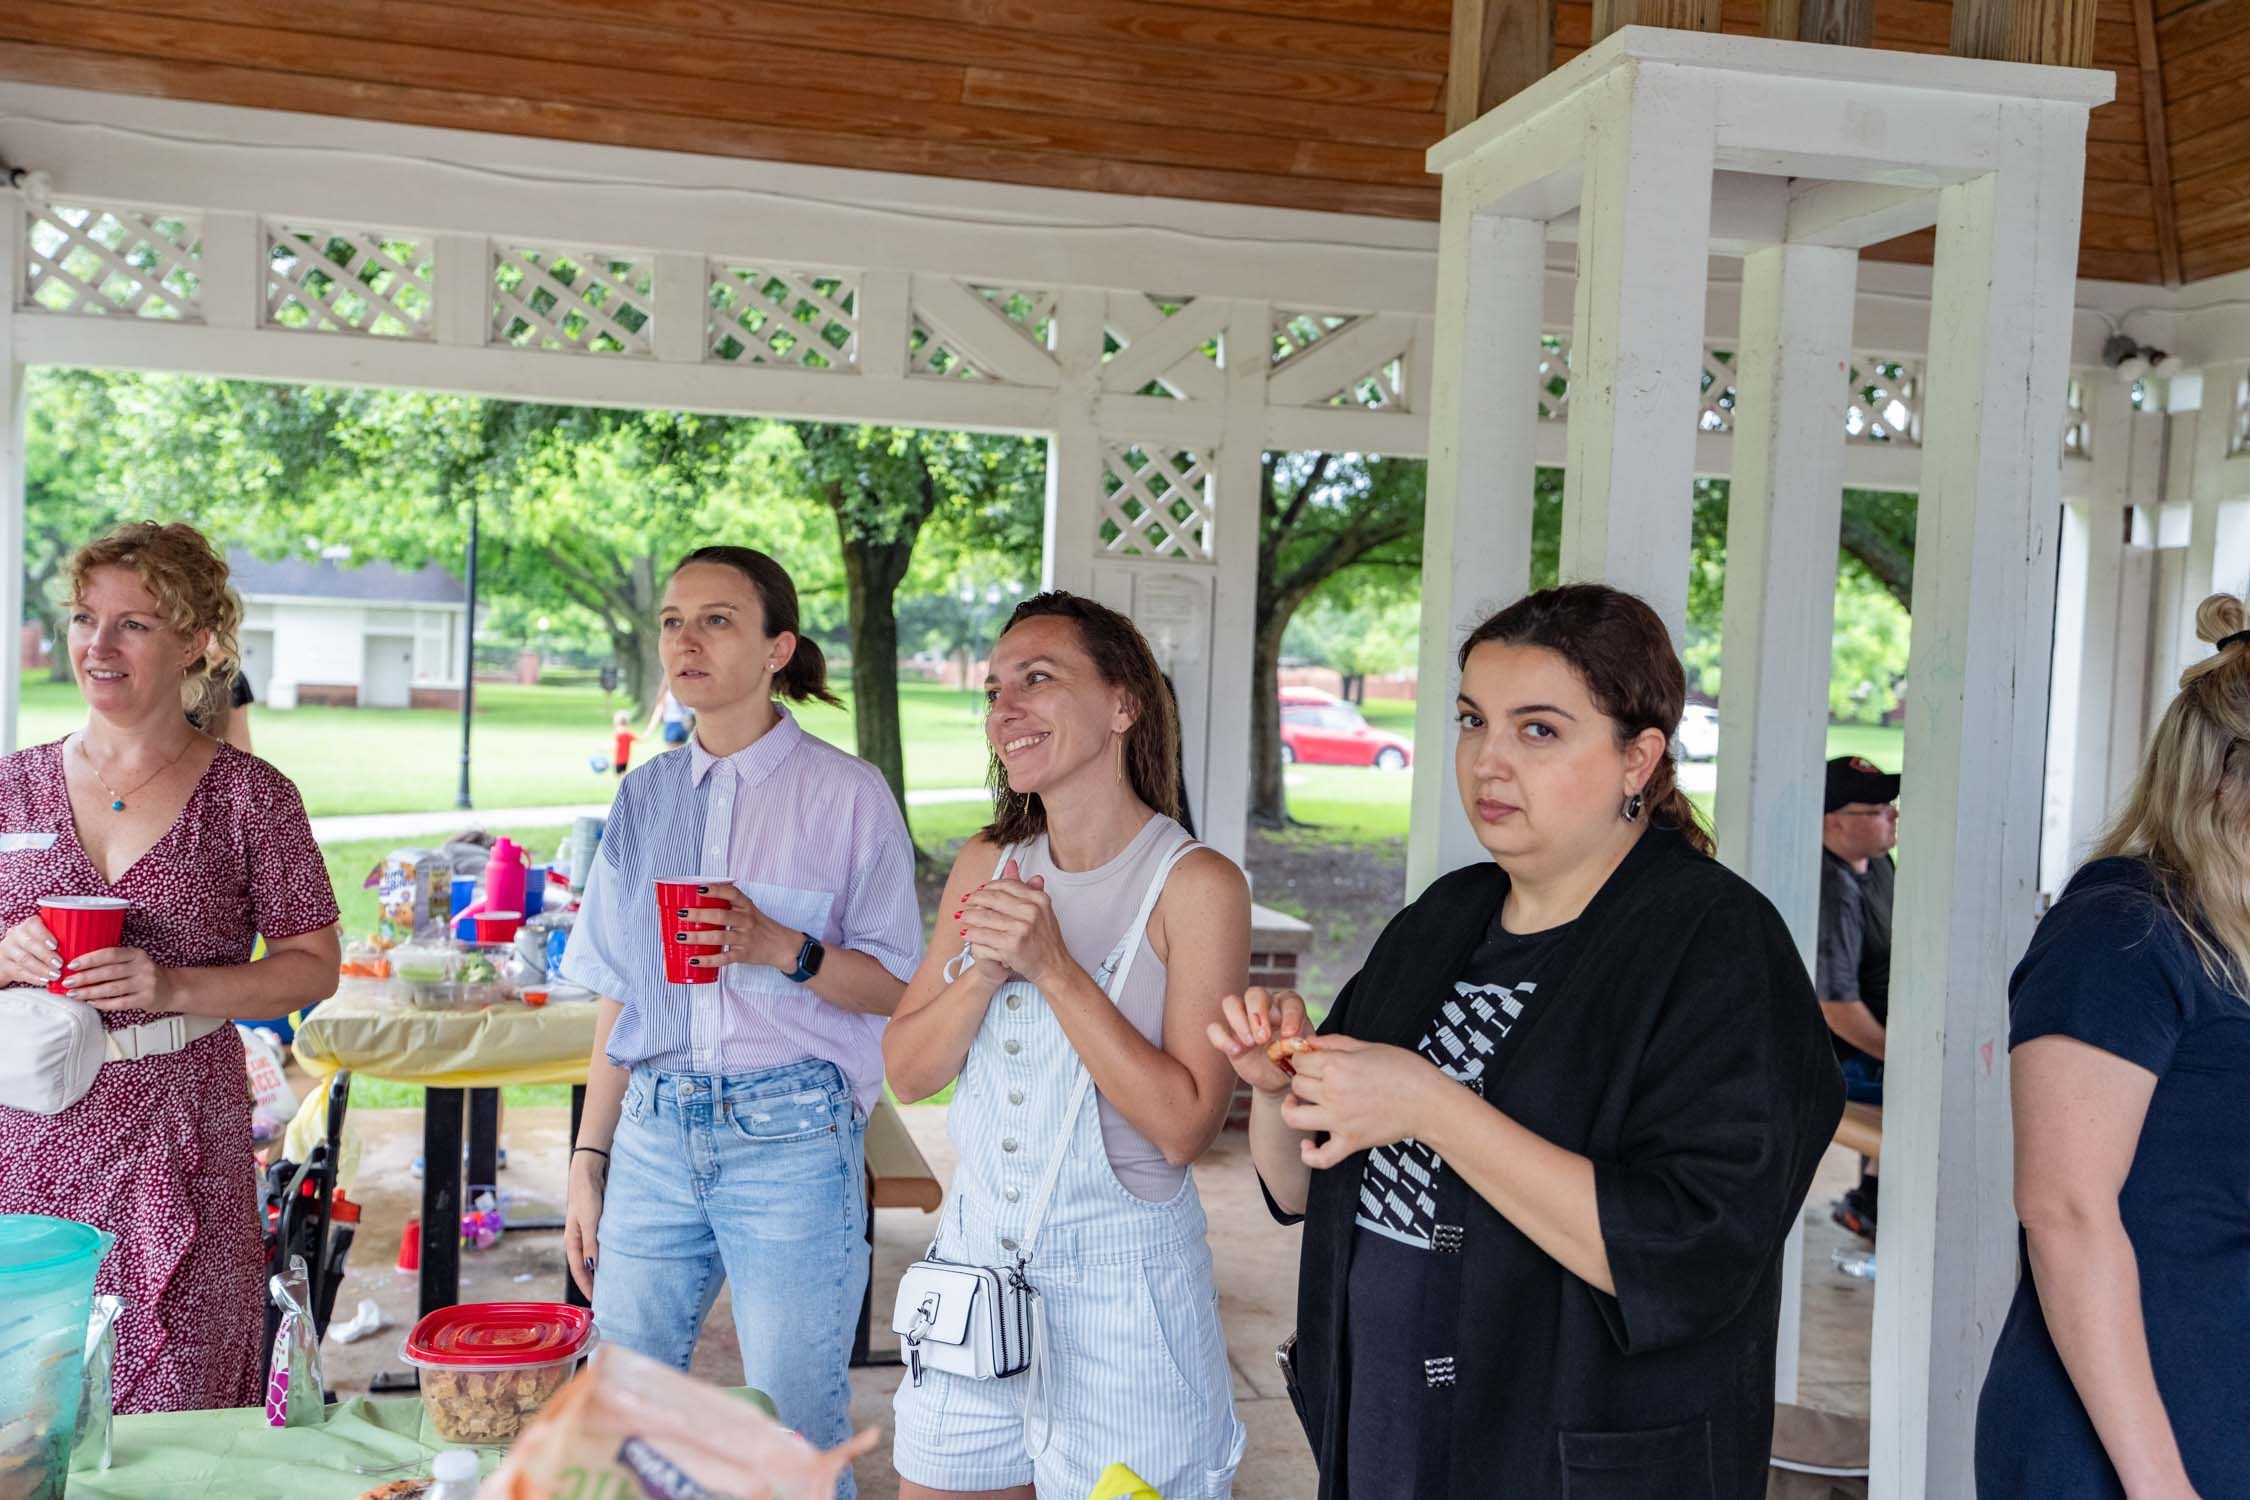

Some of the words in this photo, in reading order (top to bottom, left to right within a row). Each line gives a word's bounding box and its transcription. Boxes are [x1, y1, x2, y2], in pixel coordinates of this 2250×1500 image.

[1435, 1025, 1466, 1060] PUMA
[1368, 1147, 1398, 1184] PUMA
[1398, 1151, 1431, 1188] PUMA
[1384, 1189, 1414, 1227] PUMA
